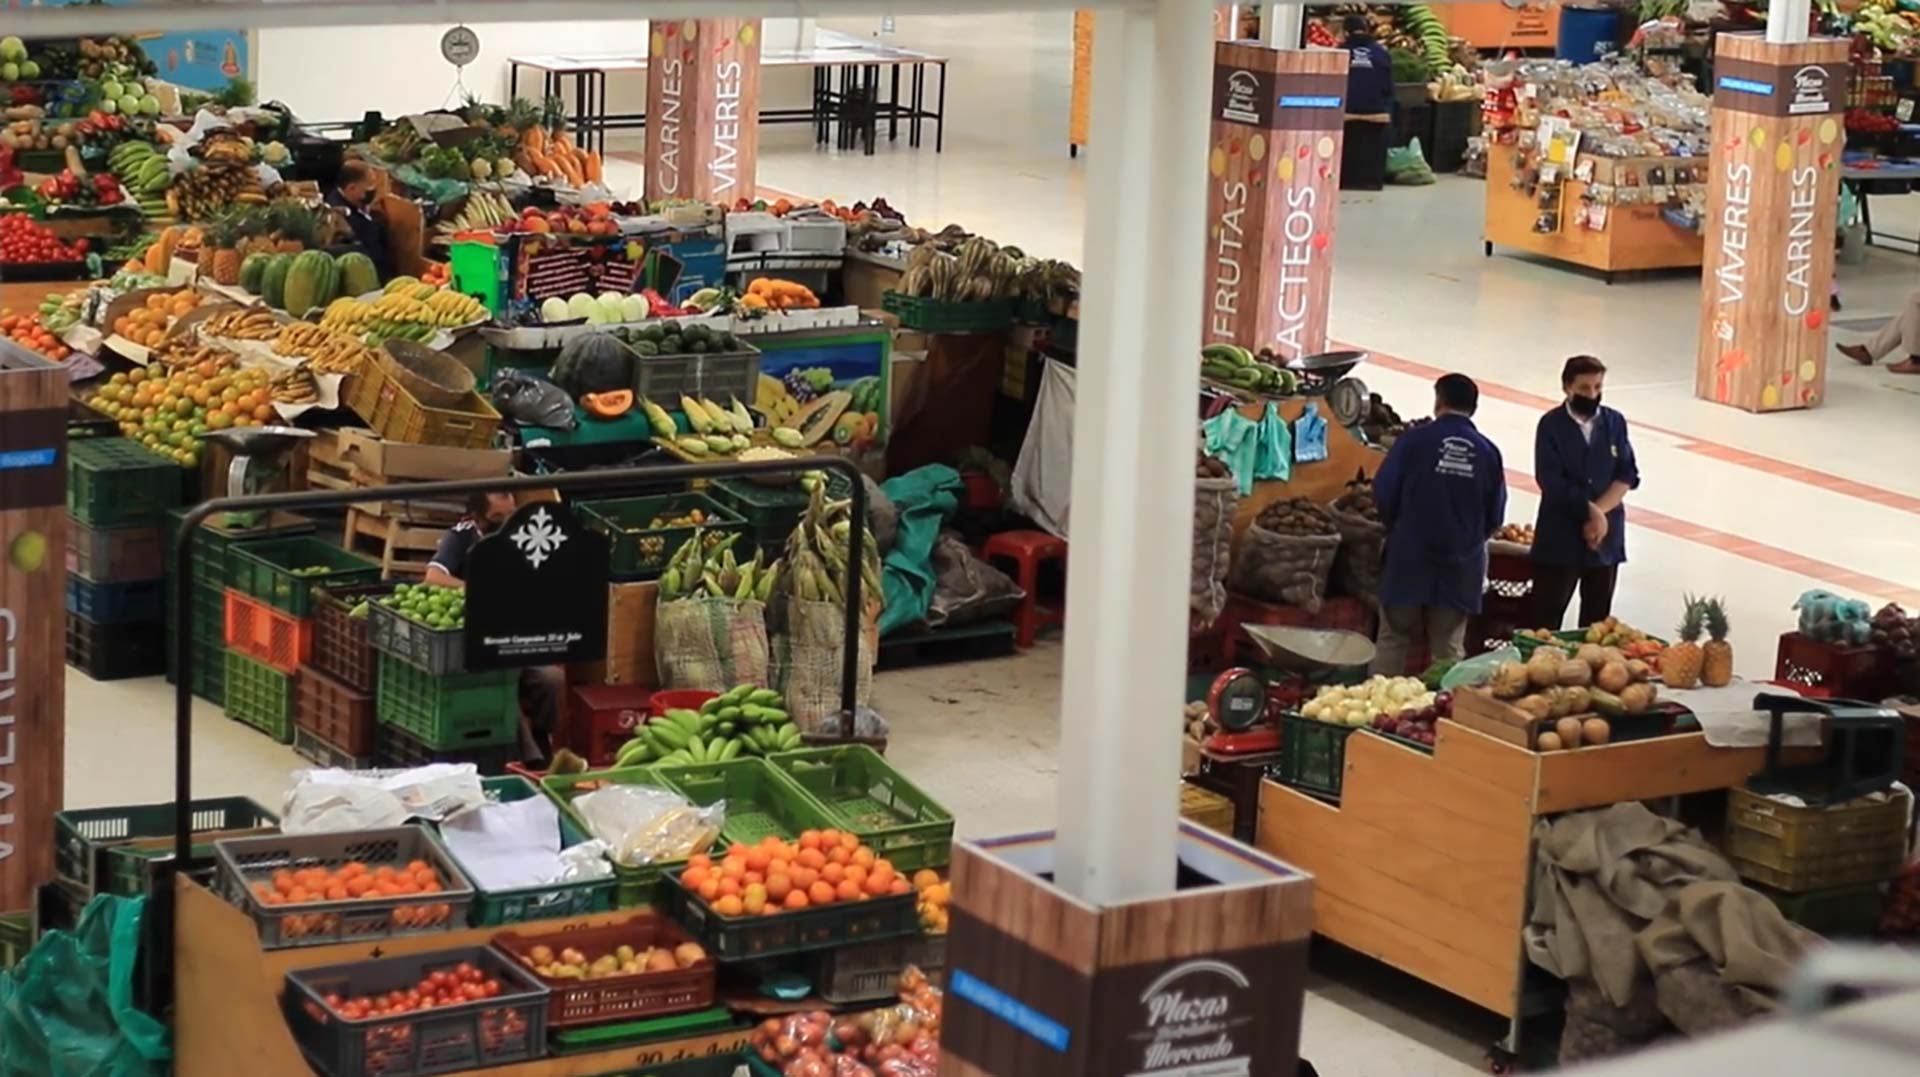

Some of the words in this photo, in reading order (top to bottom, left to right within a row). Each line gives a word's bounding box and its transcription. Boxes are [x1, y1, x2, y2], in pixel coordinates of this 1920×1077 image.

[658, 58, 682, 195] CARNES
[707, 61, 742, 194] VÍVERES
[1212, 181, 1248, 339] FRUTAS
[1715, 162, 1752, 305] VÍVERES
[1784, 166, 1817, 316] CARNES
[1143, 1034, 1234, 1070] Mercado
[1148, 991, 1229, 1027] Plazas
